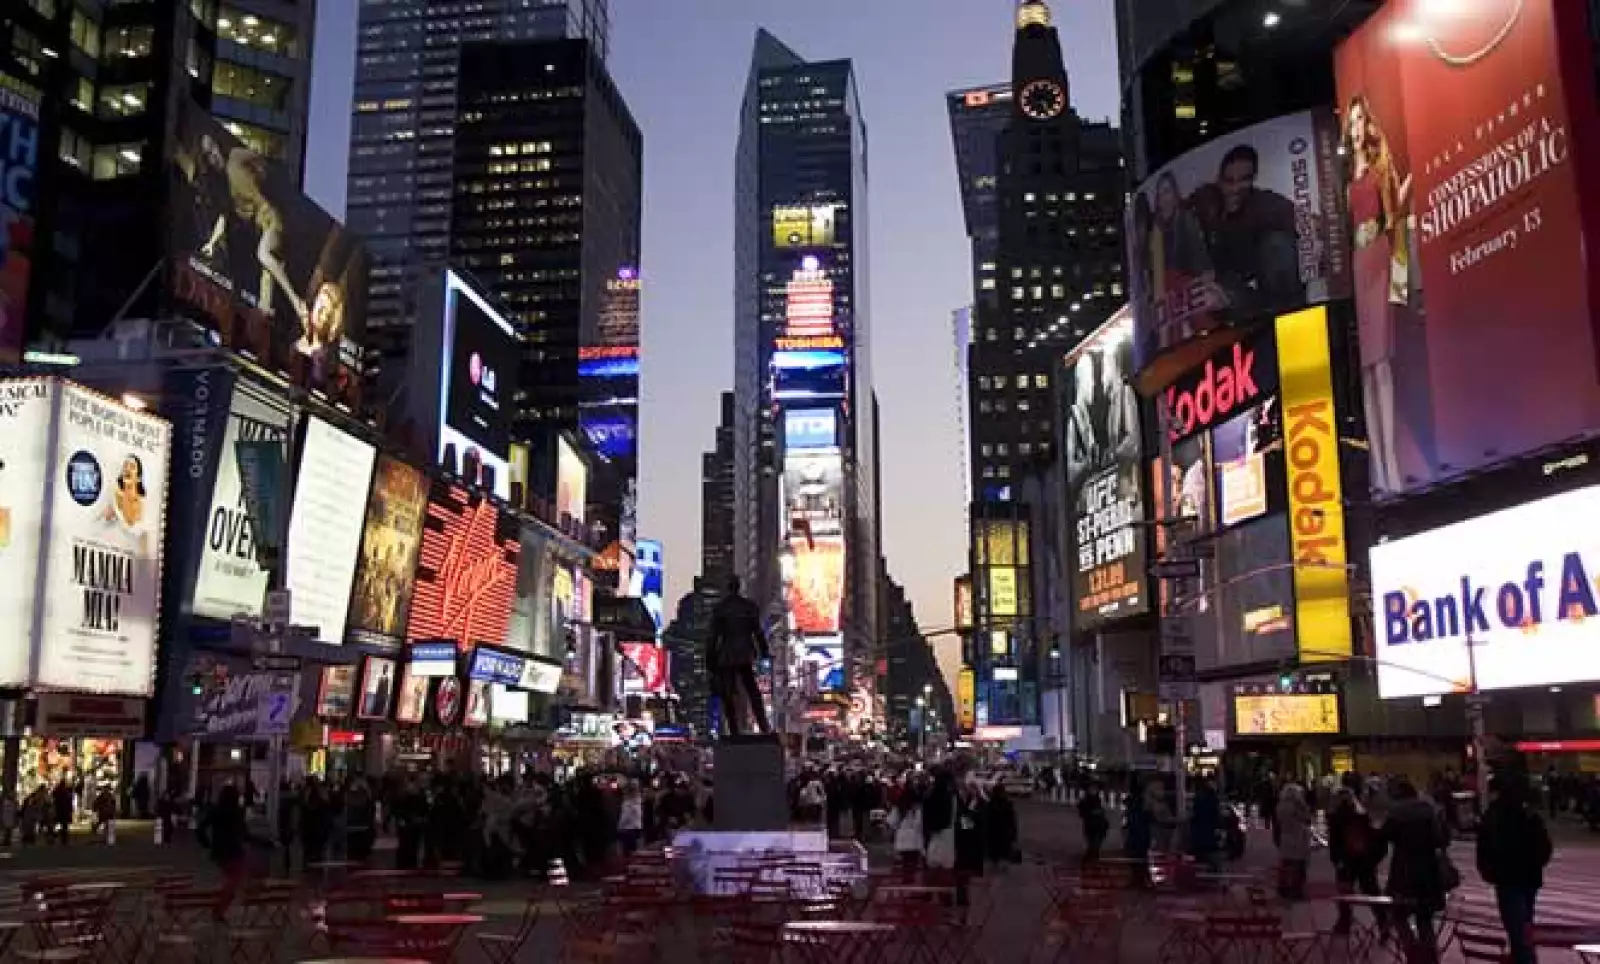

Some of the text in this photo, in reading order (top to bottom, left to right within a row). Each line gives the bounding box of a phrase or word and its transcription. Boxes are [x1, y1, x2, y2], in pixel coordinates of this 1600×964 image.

[1475, 82, 1546, 140] FISHER
[1421, 124, 1568, 244] SHOPAHOLIC
[1428, 142, 1514, 206] CONFESSIONS
[1450, 226, 1518, 275] February
[1087, 472, 1118, 514] UFC
[1287, 399, 1339, 568] Kodak
[71, 543, 133, 596] MAMMA
[1096, 527, 1135, 566] PENN
[80, 589, 119, 632] MIA!
[1383, 573, 1490, 647] Bank
[1496, 559, 1545, 628] of
